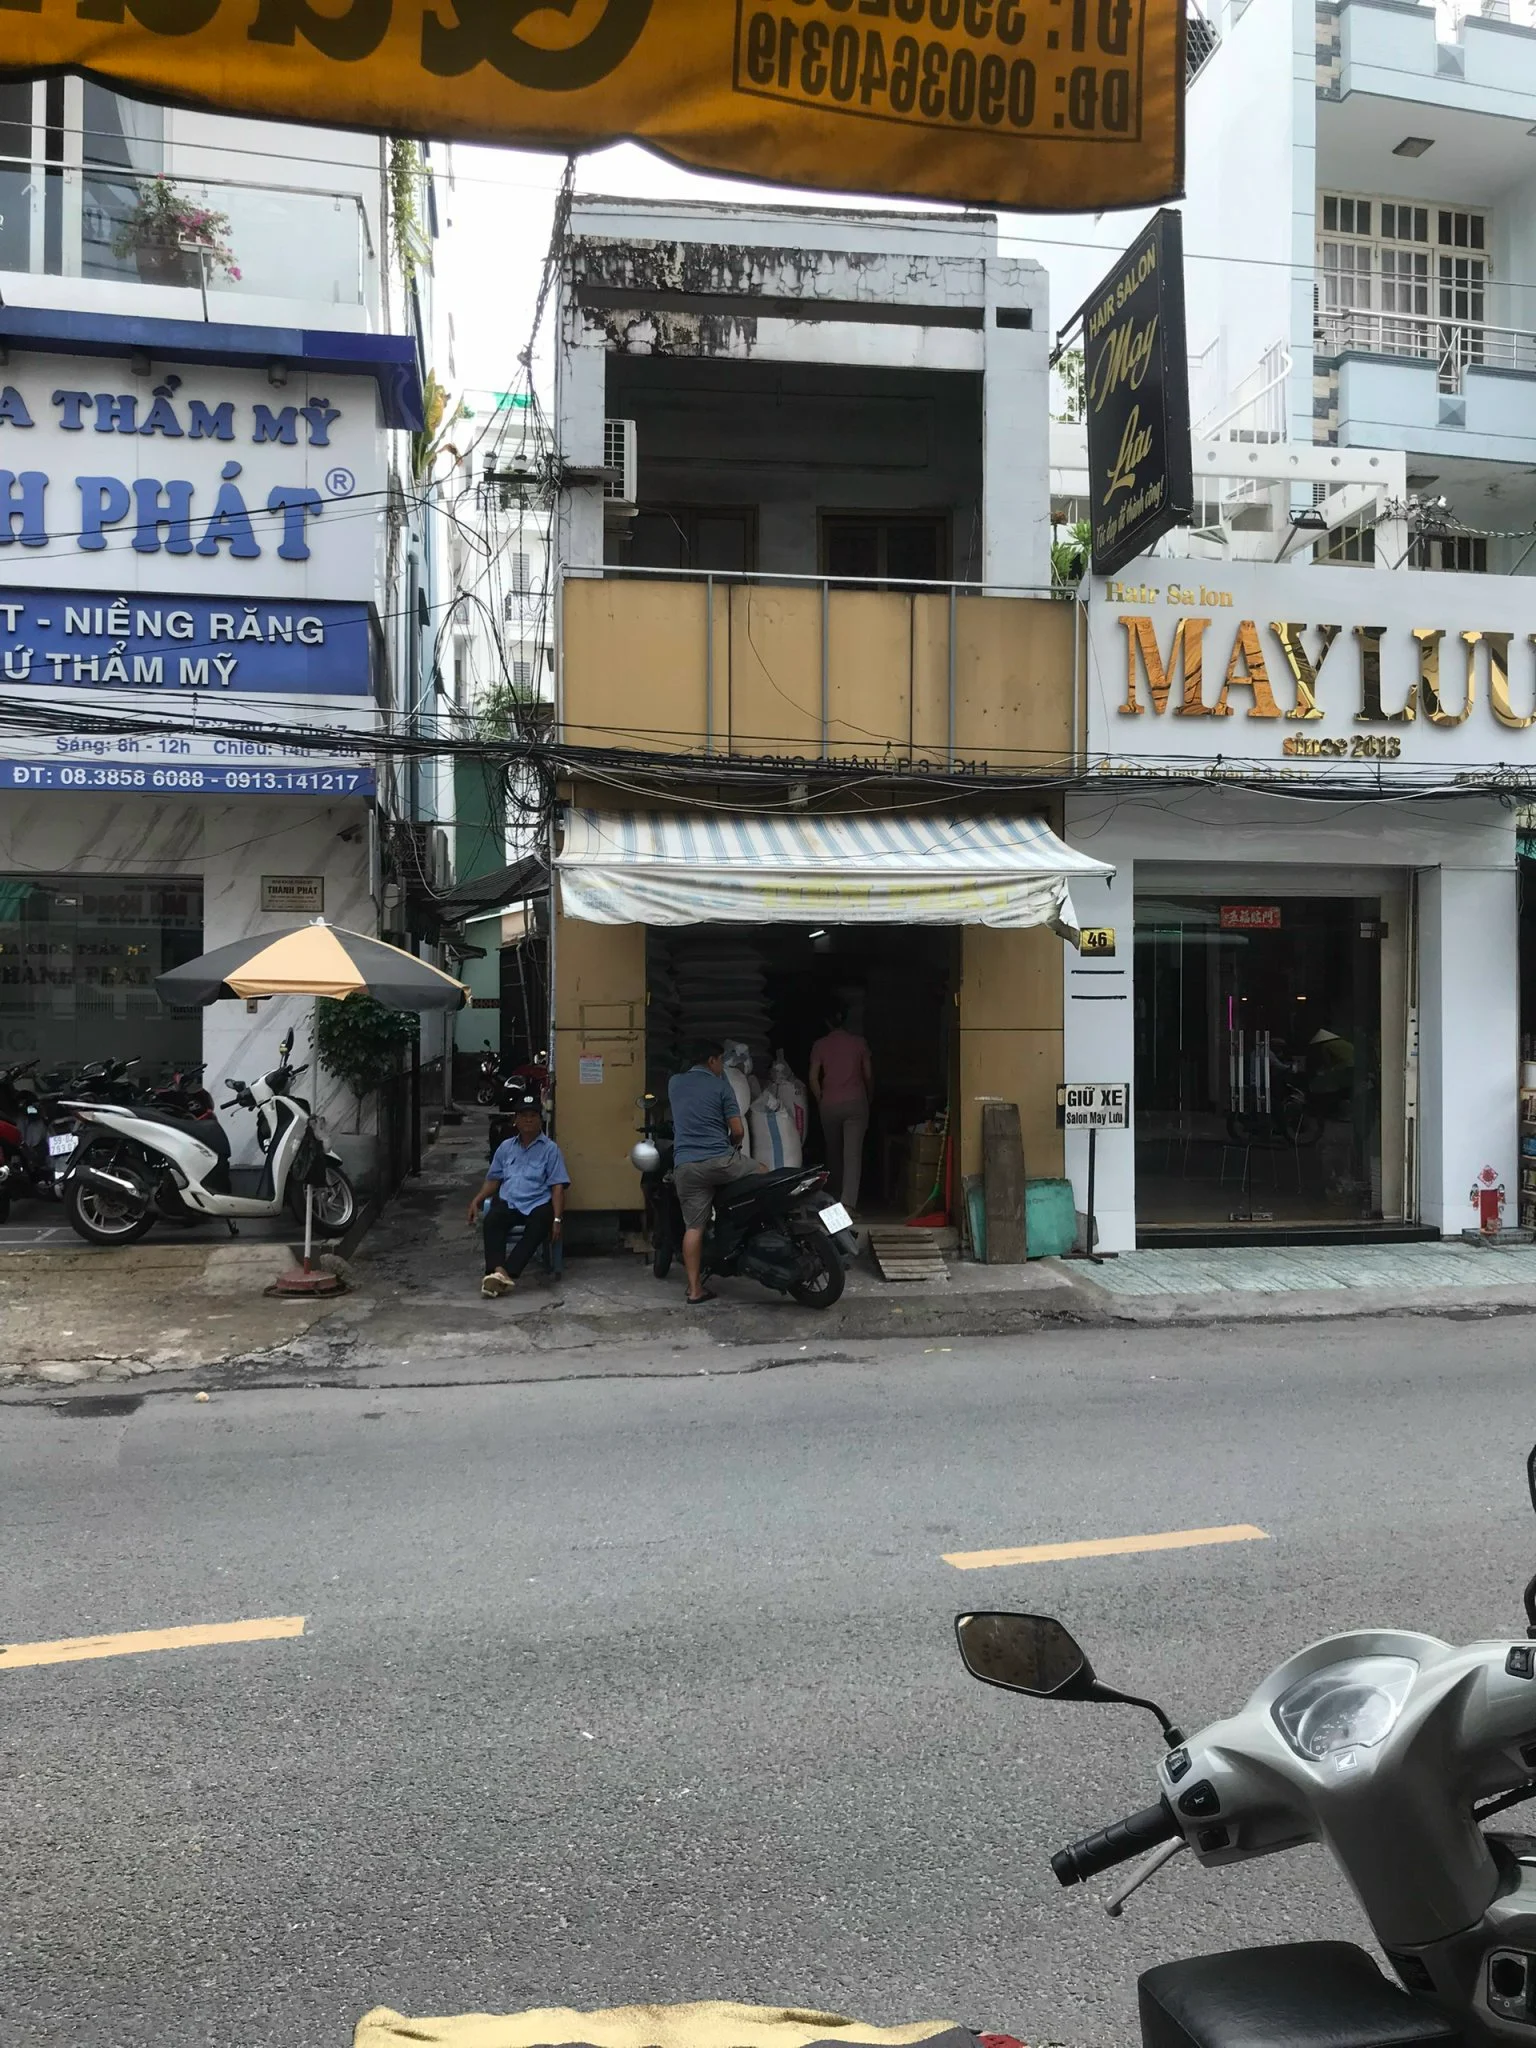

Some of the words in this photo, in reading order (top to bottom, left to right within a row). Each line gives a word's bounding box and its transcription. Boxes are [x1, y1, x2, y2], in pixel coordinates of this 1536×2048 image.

[1089, 294, 1115, 342] HAIR
[1116, 242, 1156, 309] SALON
[1090, 313, 1159, 413] May
[52, 374, 235, 440] THẨM
[252, 397, 341, 446] MỸ
[75, 460, 323, 561] PHÁT
[1105, 581, 1160, 604] Hair
[65, 597, 194, 639] NIỀNG
[209, 607, 324, 644] RĂNG
[45, 640, 163, 684] THẨM
[179, 652, 238, 686] MỸ
[56, 736, 111, 755] Sáng:
[118, 738, 139, 752] 8h
[159, 739, 191, 754] 12h
[1282, 731, 1348, 757] since
[1350, 734, 1401, 759] 2013
[13, 766, 52, 784] ĐT:
[60, 768, 145, 786] 08.3858
[152, 770, 204, 788] 6088
[225, 772, 359, 791] 0913.141217
[1087, 932, 1108, 947] 46
[1067, 1086, 1095, 1107] GIỮ
[1101, 1089, 1123, 1106] XE
[1066, 1111, 1088, 1124] Salon
[1090, 1111, 1107, 1126] May
[1108, 1111, 1123, 1124] Lưu
